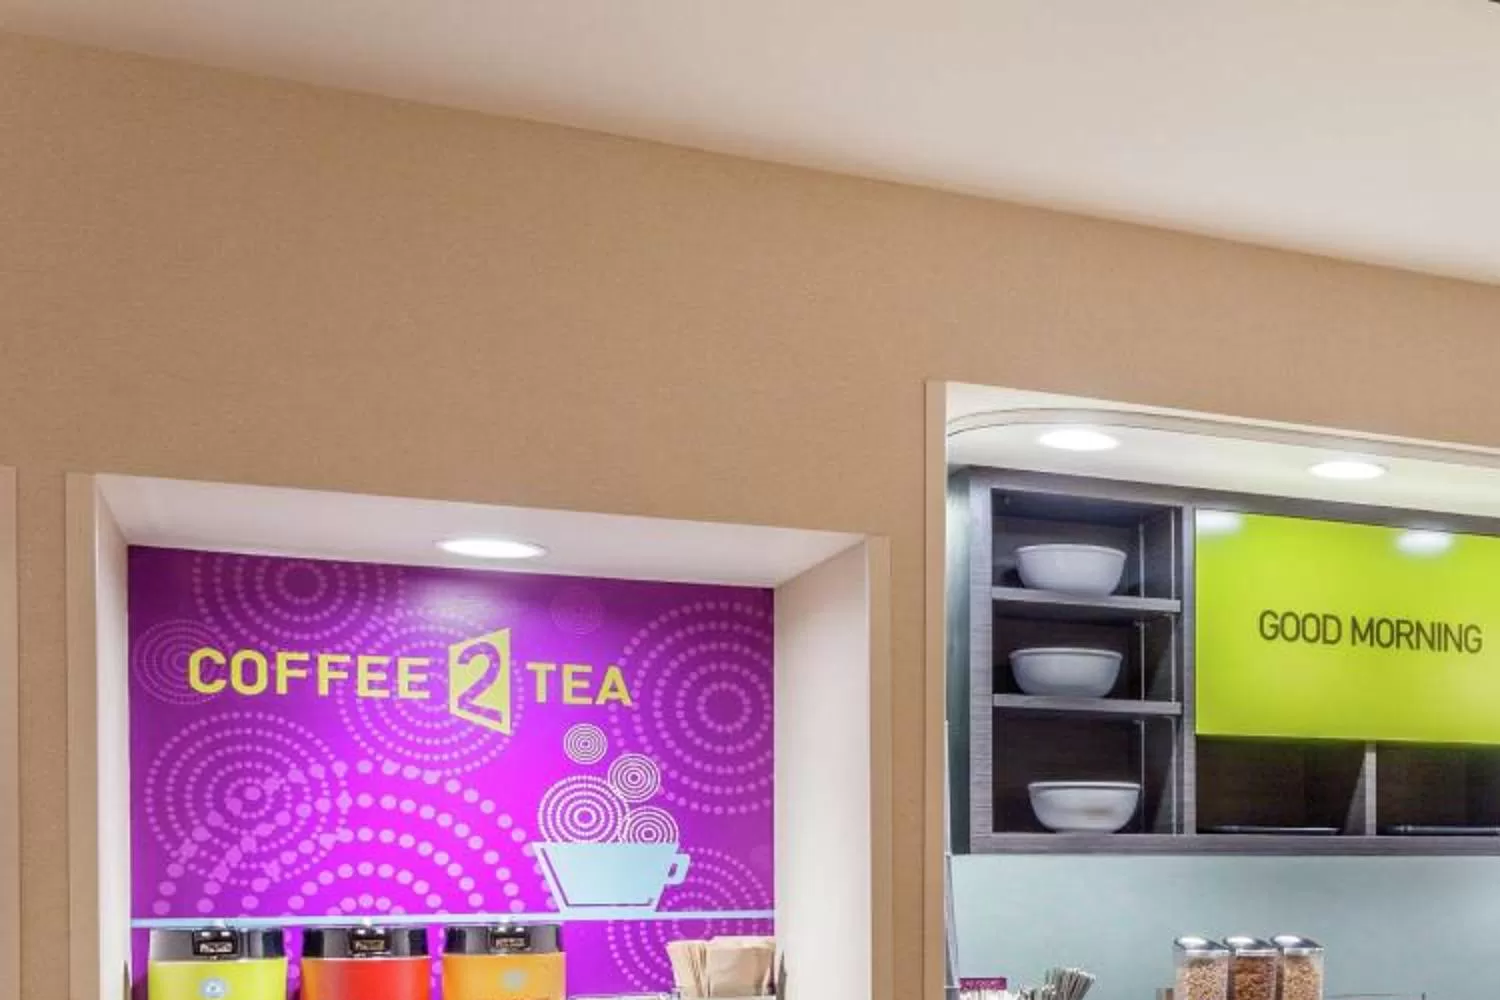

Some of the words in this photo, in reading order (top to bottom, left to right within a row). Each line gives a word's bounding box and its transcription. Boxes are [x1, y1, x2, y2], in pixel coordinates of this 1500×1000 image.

[1259, 609, 1342, 645] GOOD
[1350, 615, 1483, 654] MORNING
[188, 647, 431, 699] COFFEE
[456, 641, 506, 724] 2
[526, 661, 632, 707] TEA
